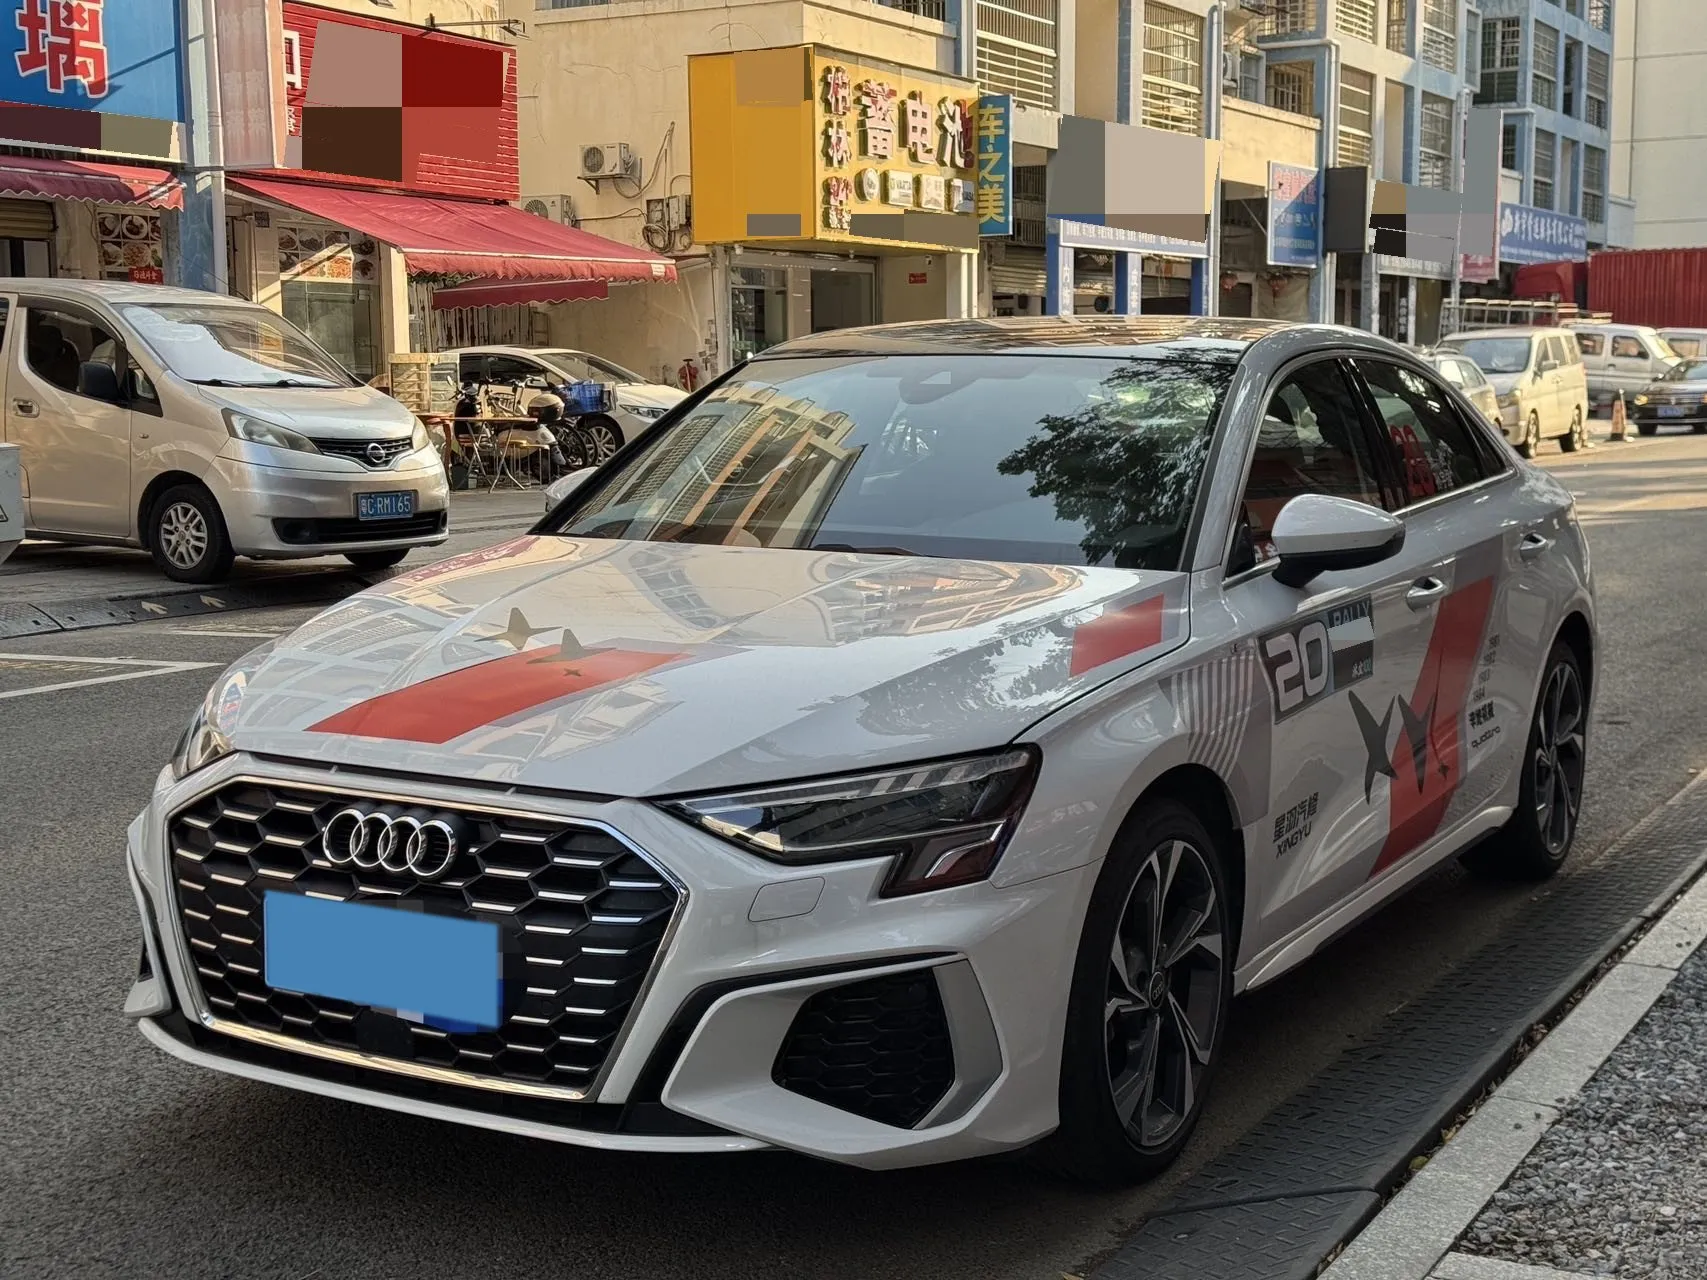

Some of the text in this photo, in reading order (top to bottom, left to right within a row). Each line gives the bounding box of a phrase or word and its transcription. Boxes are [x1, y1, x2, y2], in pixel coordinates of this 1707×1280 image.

[857, 79, 974, 168] 蓄电池
[979, 104, 1006, 223] 车之美
[1266, 621, 1328, 712] 20
[1471, 726, 1501, 748] quattro
[1276, 821, 1312, 859] XINGYU
